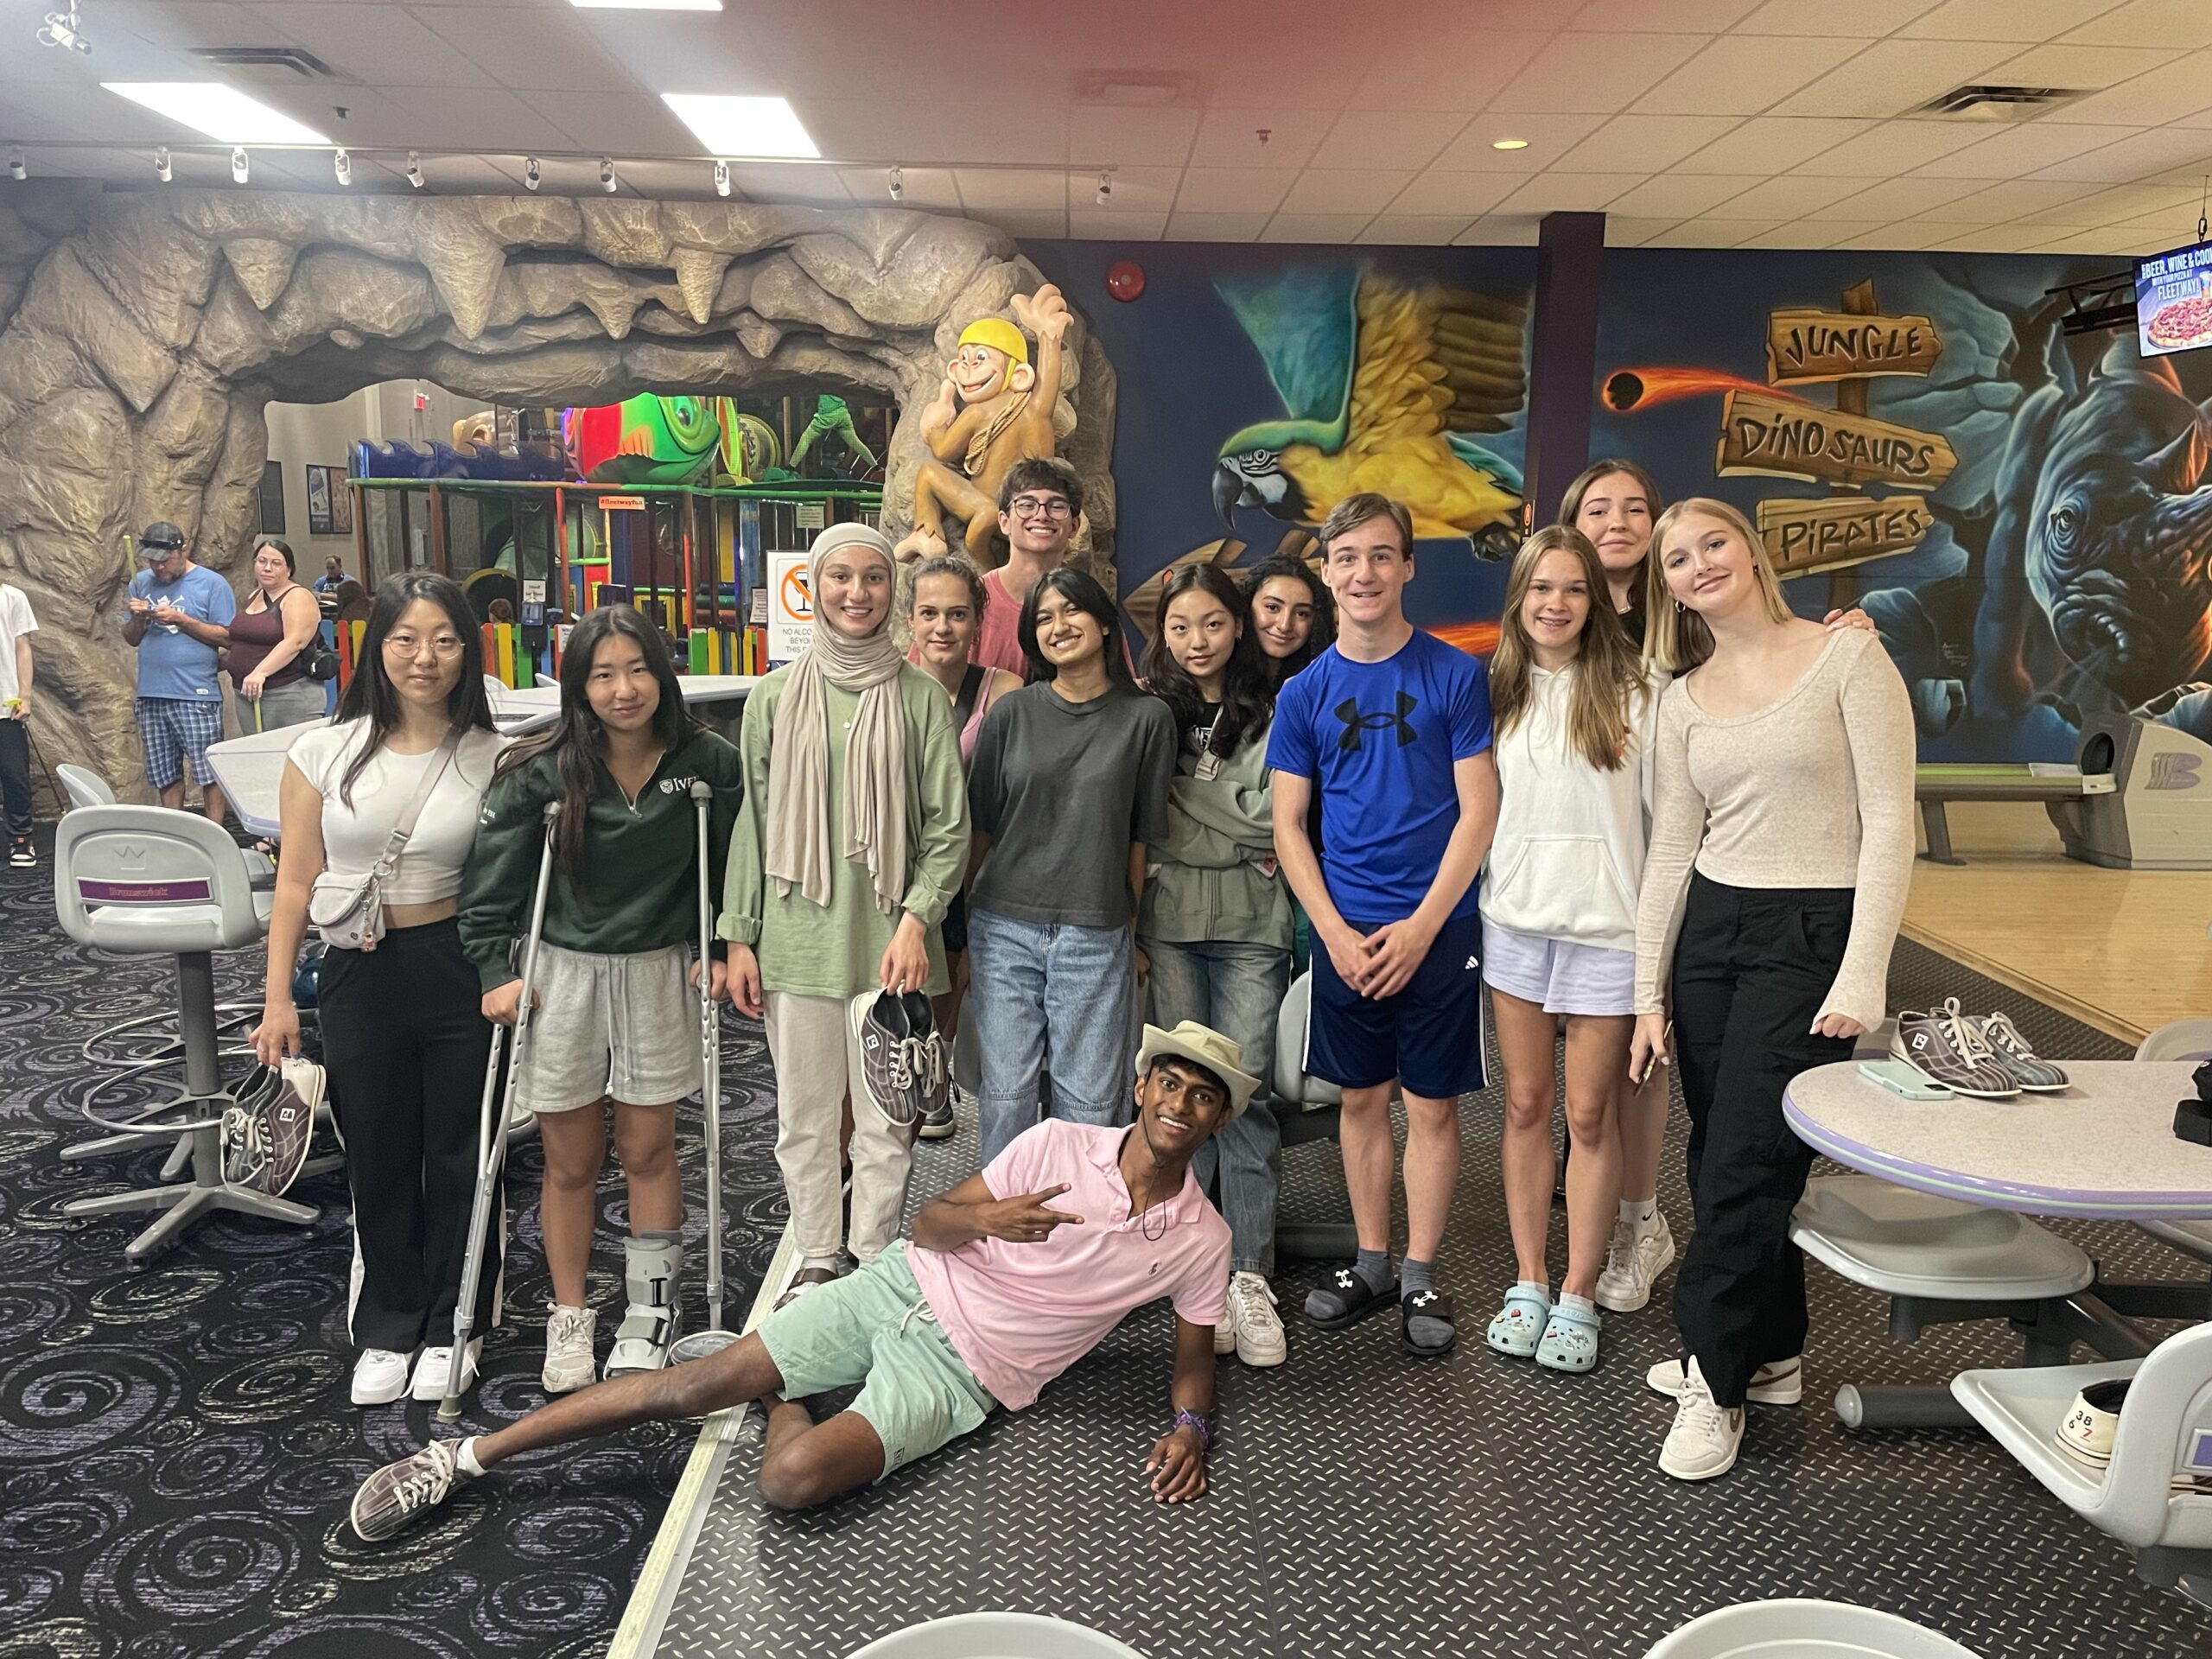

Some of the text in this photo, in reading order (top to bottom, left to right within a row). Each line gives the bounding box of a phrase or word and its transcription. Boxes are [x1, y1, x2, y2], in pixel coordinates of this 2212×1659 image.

[2145, 259, 2168, 279] BEER,
[2167, 254, 2188, 273] WINE
[2188, 253, 2195, 269] &
[2158, 276, 2200, 301] FLEETWAY!
[1785, 324, 1923, 368] JUNGLE
[2069, 1420, 2075, 1429] 6
[2075, 1410, 2093, 1427] 38
